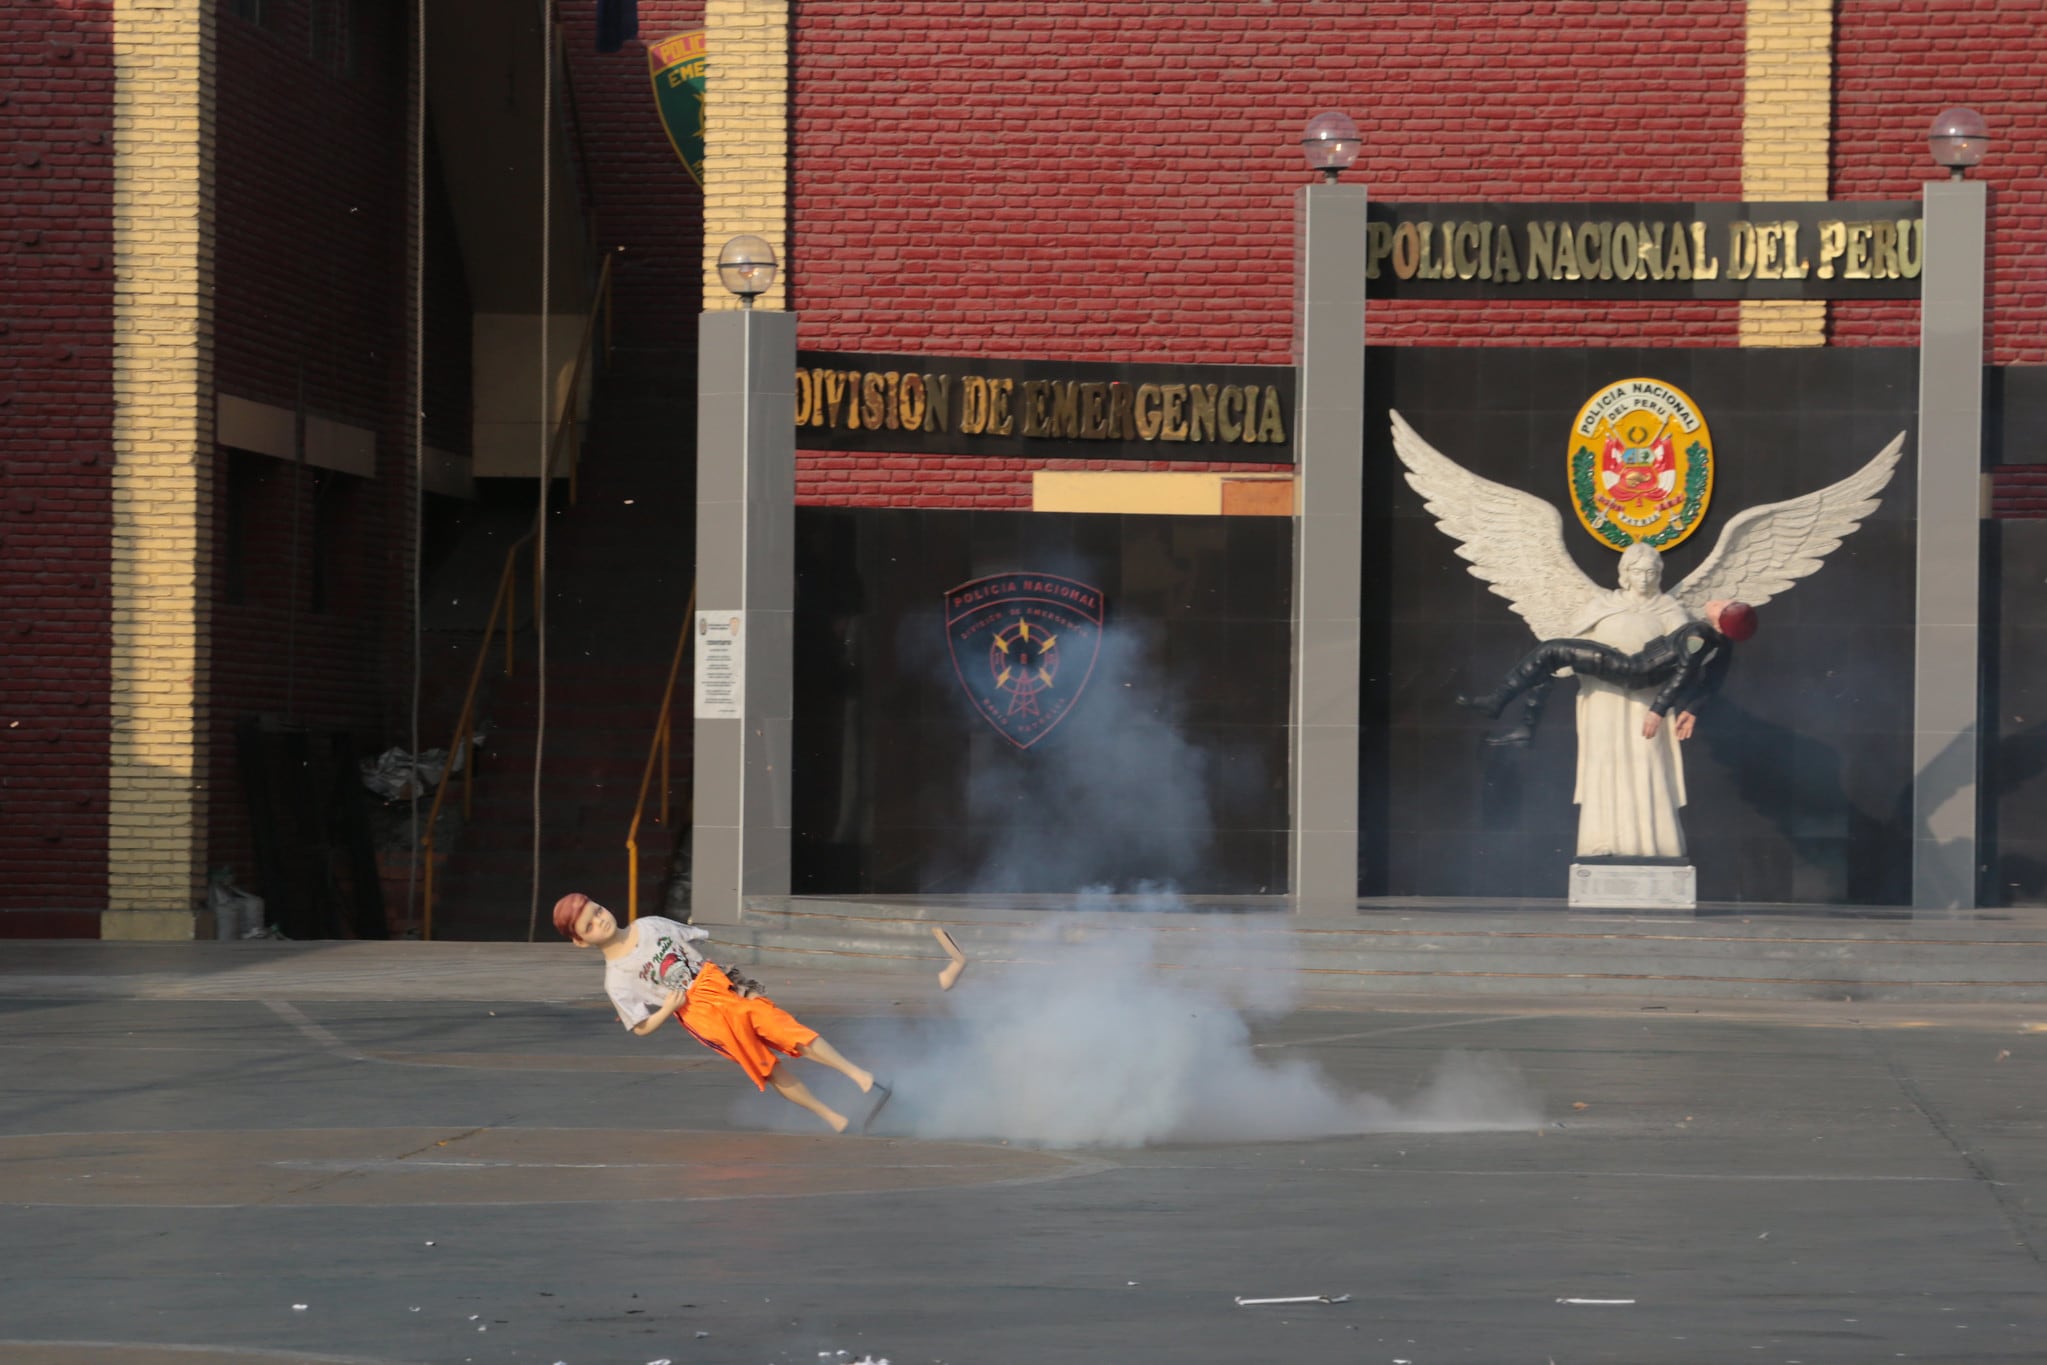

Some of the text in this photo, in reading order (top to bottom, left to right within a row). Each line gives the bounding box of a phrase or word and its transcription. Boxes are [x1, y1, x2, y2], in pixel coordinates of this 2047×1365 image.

[1367, 219, 1923, 283] POLICIA NACIONAL DEL PERU
[796, 367, 1287, 444] DIVISION DE EMERGENCIA
[1581, 383, 1696, 434] POLICIA NACIONAL
[1608, 398, 1667, 421] DEL PERU
[953, 580, 1096, 609] POLICIA NACIONAL
